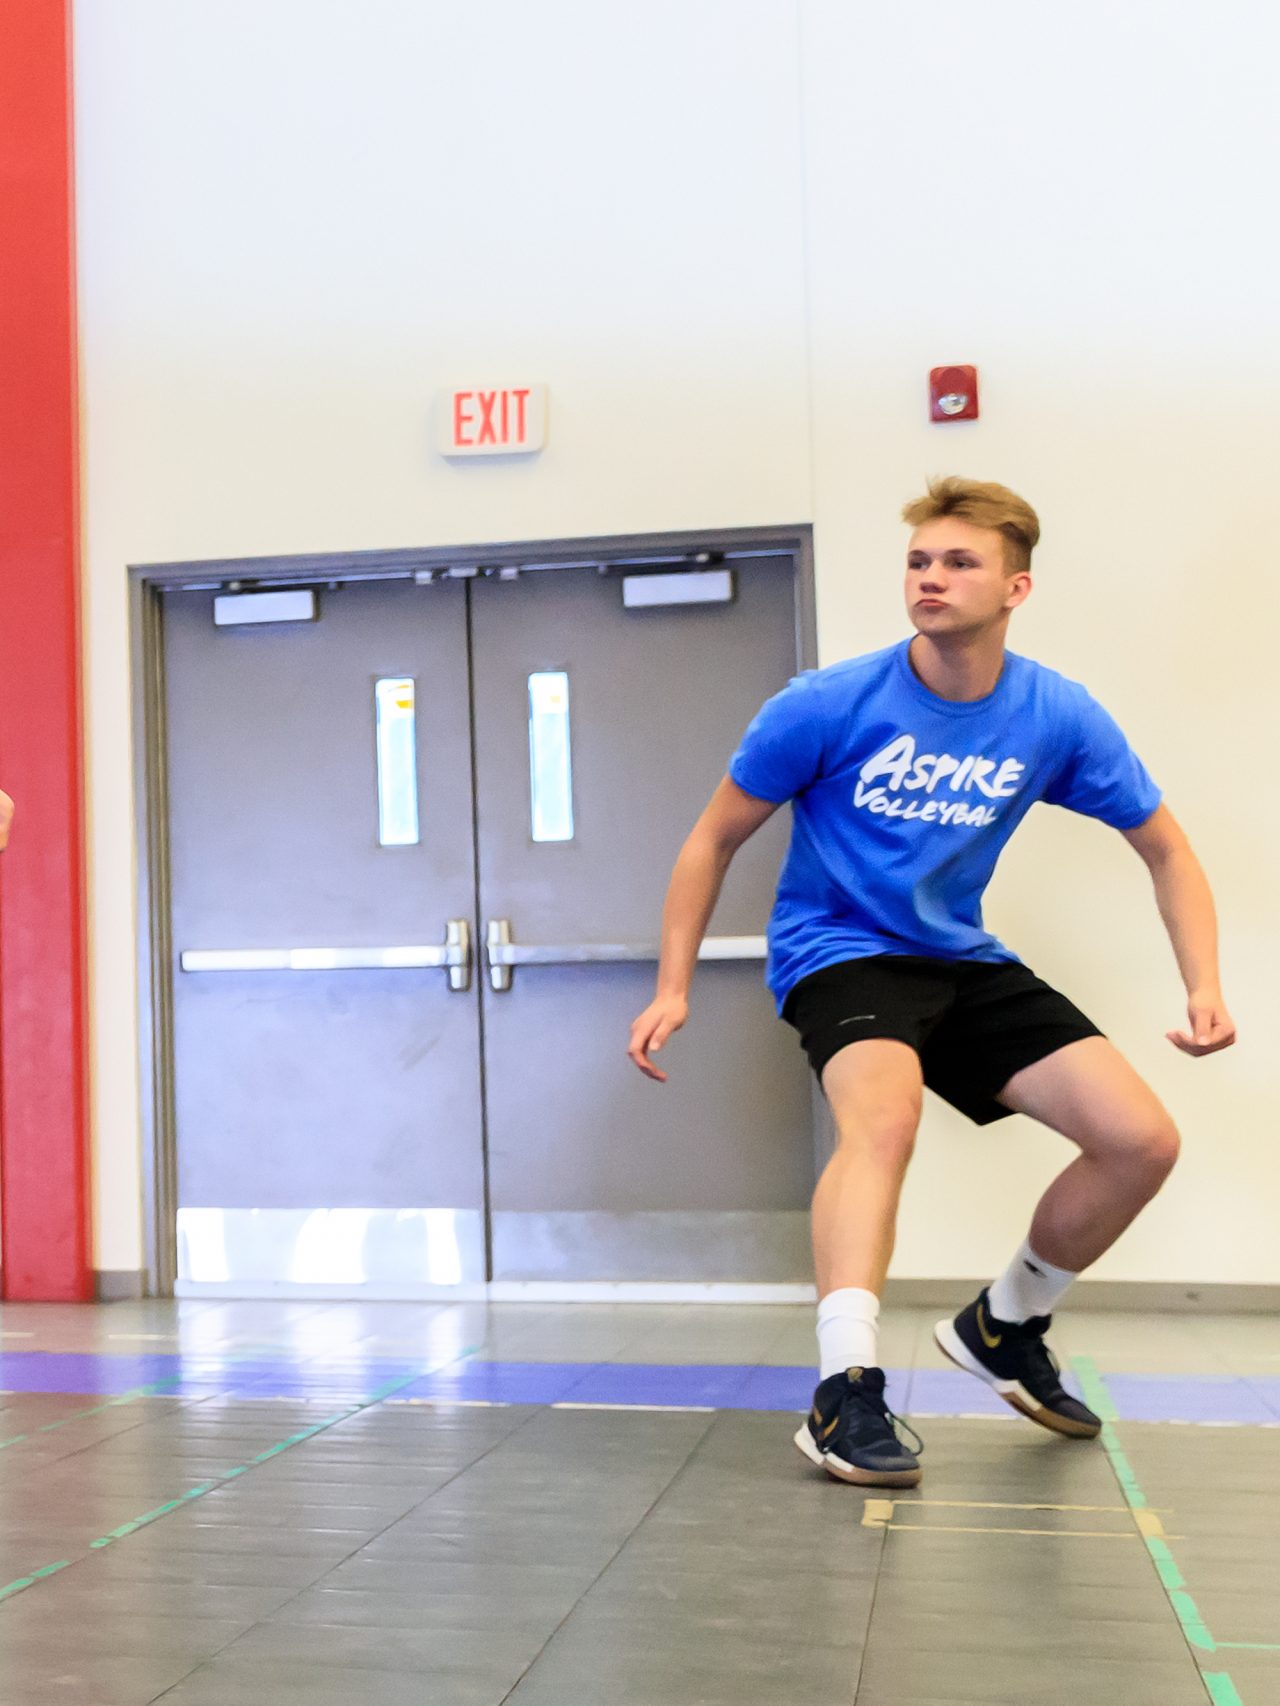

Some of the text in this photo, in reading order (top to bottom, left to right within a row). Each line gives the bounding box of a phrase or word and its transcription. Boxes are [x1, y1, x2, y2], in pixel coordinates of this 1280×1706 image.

[454, 389, 530, 446] EXIT
[859, 734, 1025, 798] ASPIRE
[853, 780, 997, 828] VOLLEYBAL
